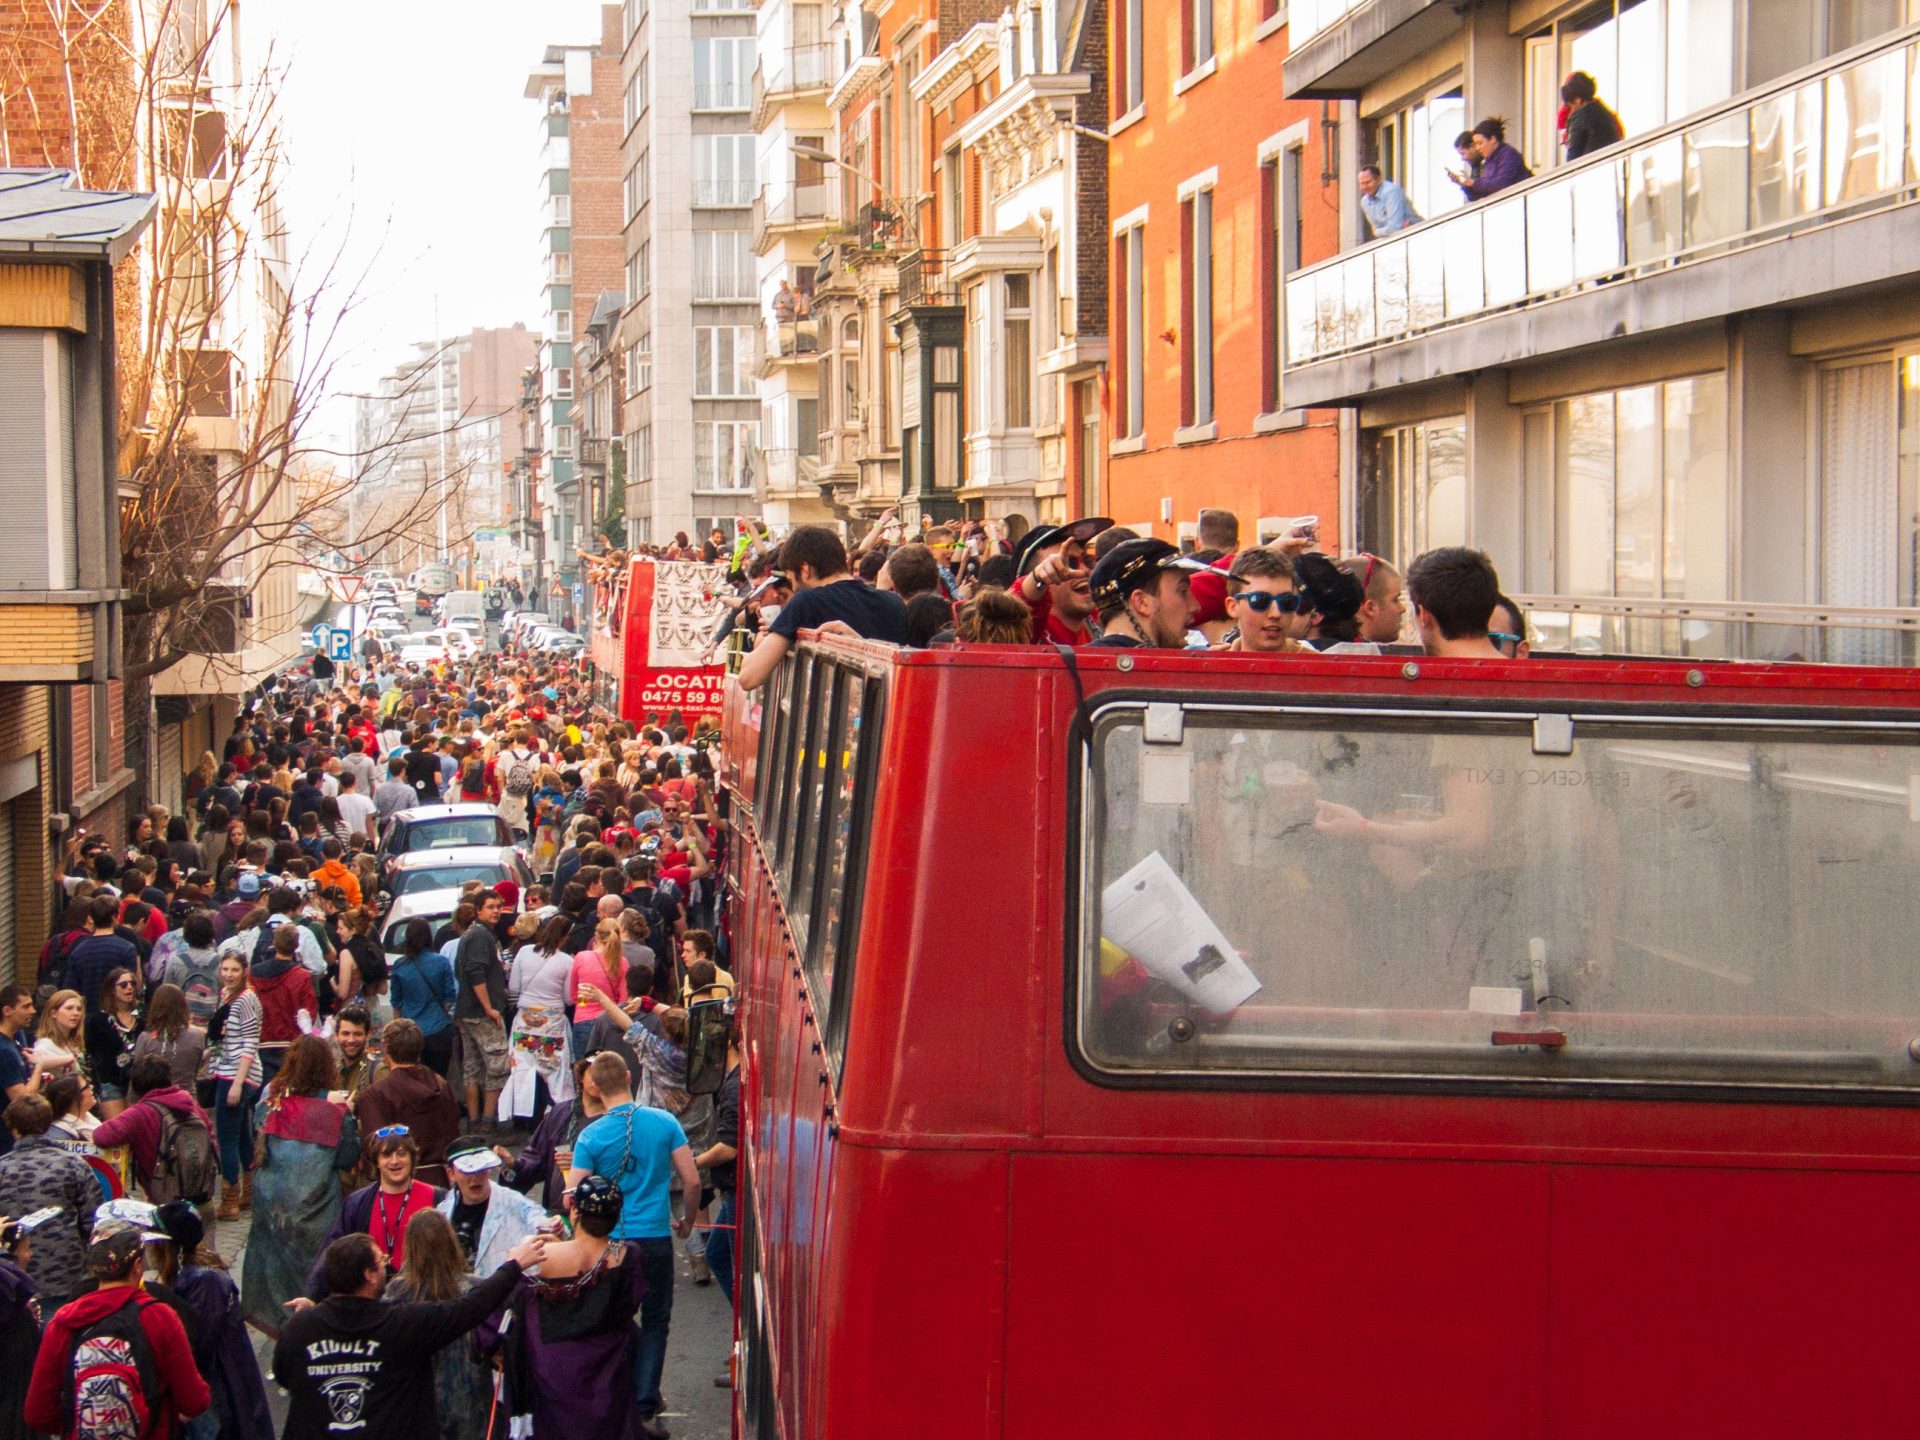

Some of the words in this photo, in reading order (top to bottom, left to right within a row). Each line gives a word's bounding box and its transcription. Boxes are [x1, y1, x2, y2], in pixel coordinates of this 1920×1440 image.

[331, 633, 349, 657] P
[642, 691, 682, 702] 0475
[686, 692, 706, 703] 59
[710, 692, 723, 703] 8
[307, 1361, 383, 1375] UNIVERSITY
